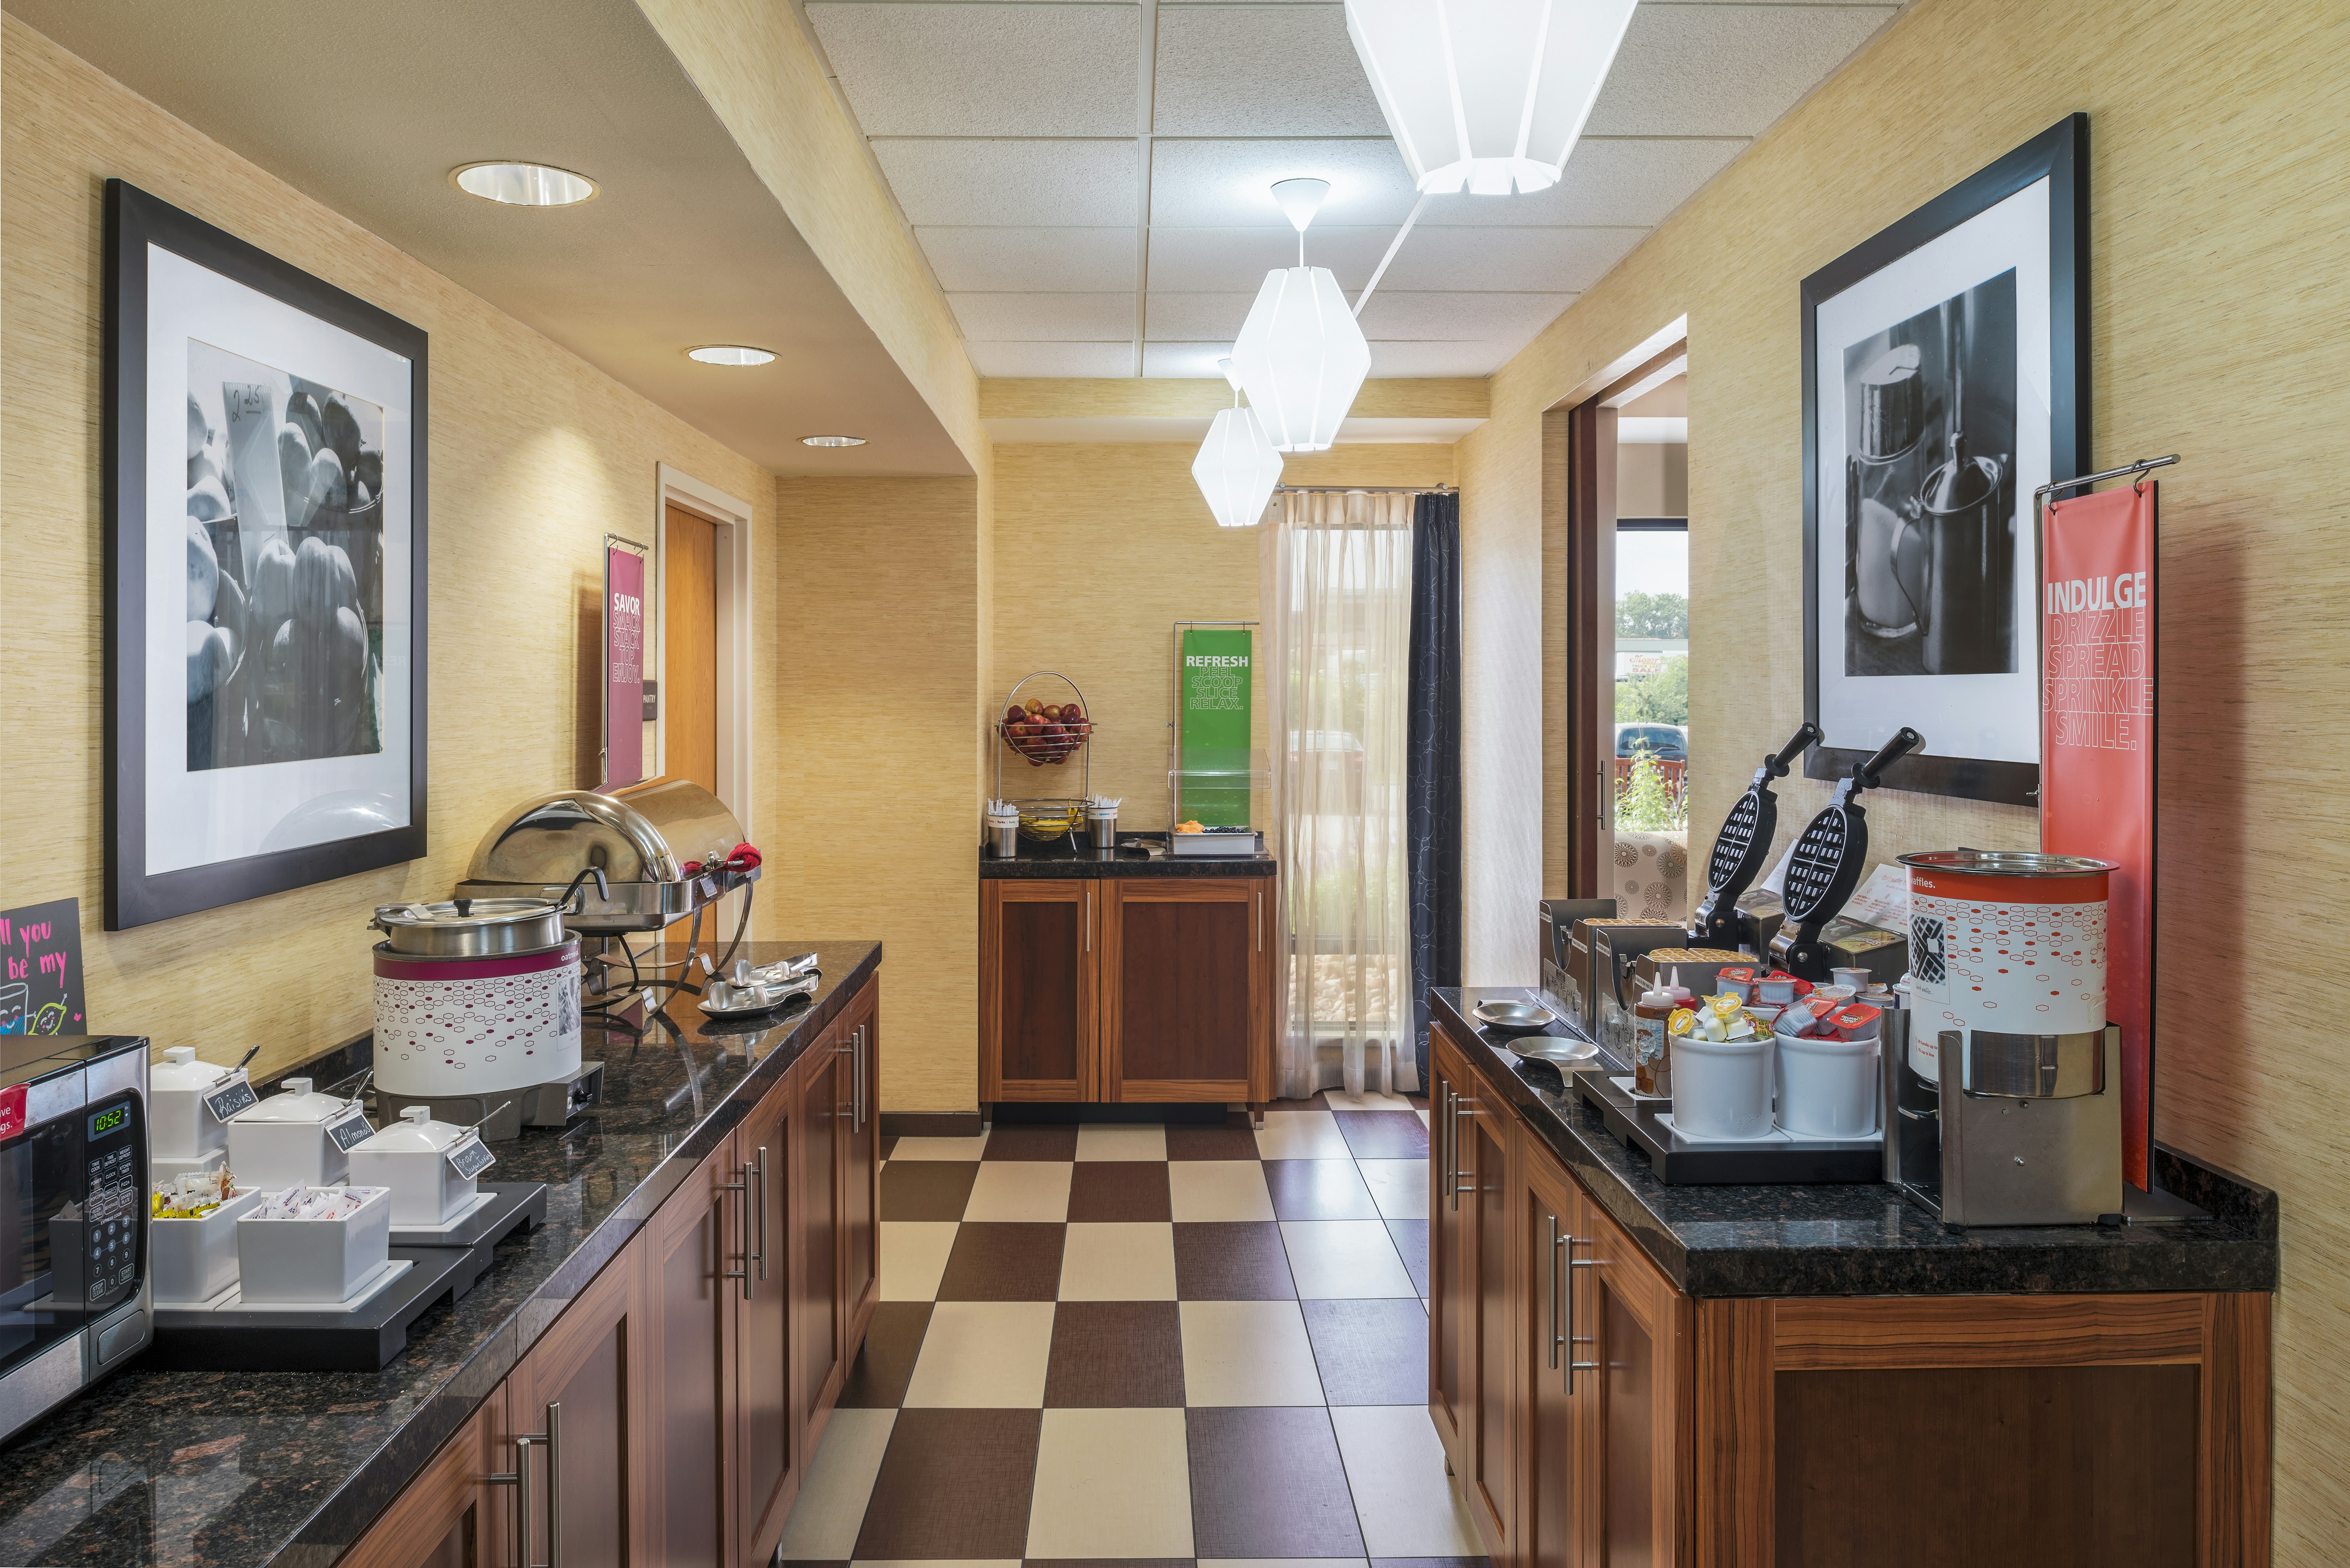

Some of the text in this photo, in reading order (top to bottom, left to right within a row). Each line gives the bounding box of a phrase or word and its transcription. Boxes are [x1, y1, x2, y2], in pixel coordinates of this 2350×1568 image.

[2048, 571, 2146, 614] INDULGE
[614, 593, 640, 615] SAVOR
[613, 610, 641, 632] SNACK
[2049, 606, 2145, 646] DRIZZLE
[614, 628, 639, 649] STACK
[619, 646, 634, 665] TOP
[2049, 642, 2146, 679] SPREAD
[1186, 656, 1248, 667] REFRESH
[613, 663, 639, 683] ENJOY.
[1200, 666, 1235, 677] PEEL
[1192, 676, 1243, 688] SCOOP
[1196, 687, 1237, 699] SLICE
[2042, 678, 2154, 715] SPRINKLE
[643, 695, 656, 703] PANTRY
[1190, 698, 1243, 709] RELAX.
[2056, 710, 2137, 750] SMILE.
[20, 921, 51, 958] you
[1846, 936, 1881, 945] WAFFLES
[561, 948, 579, 961] oatmeal.
[8, 951, 66, 988] be my
[96, 1110, 121, 1131] 10:52
[119, 1152, 131, 1160] DEFROST
[456, 1150, 477, 1168] Brown
[104, 1158, 116, 1167] DEFROST
[120, 1162, 131, 1171] KITCHEN
[91, 1178, 102, 1186] POWER
[105, 1186, 117, 1195] POTATO
[91, 1193, 103, 1202] POPCORN
[120, 1192, 131, 1201] DINNER
[104, 1201, 118, 1210] BEVERAGE
[100, 1216, 113, 1225] EXPRESS
[121, 1266, 132, 1276] START
[93, 1282, 103, 1292] STOP
[105, 1286, 119, 1296] MEMORY
[93, 1289, 103, 1298] CLEAR
